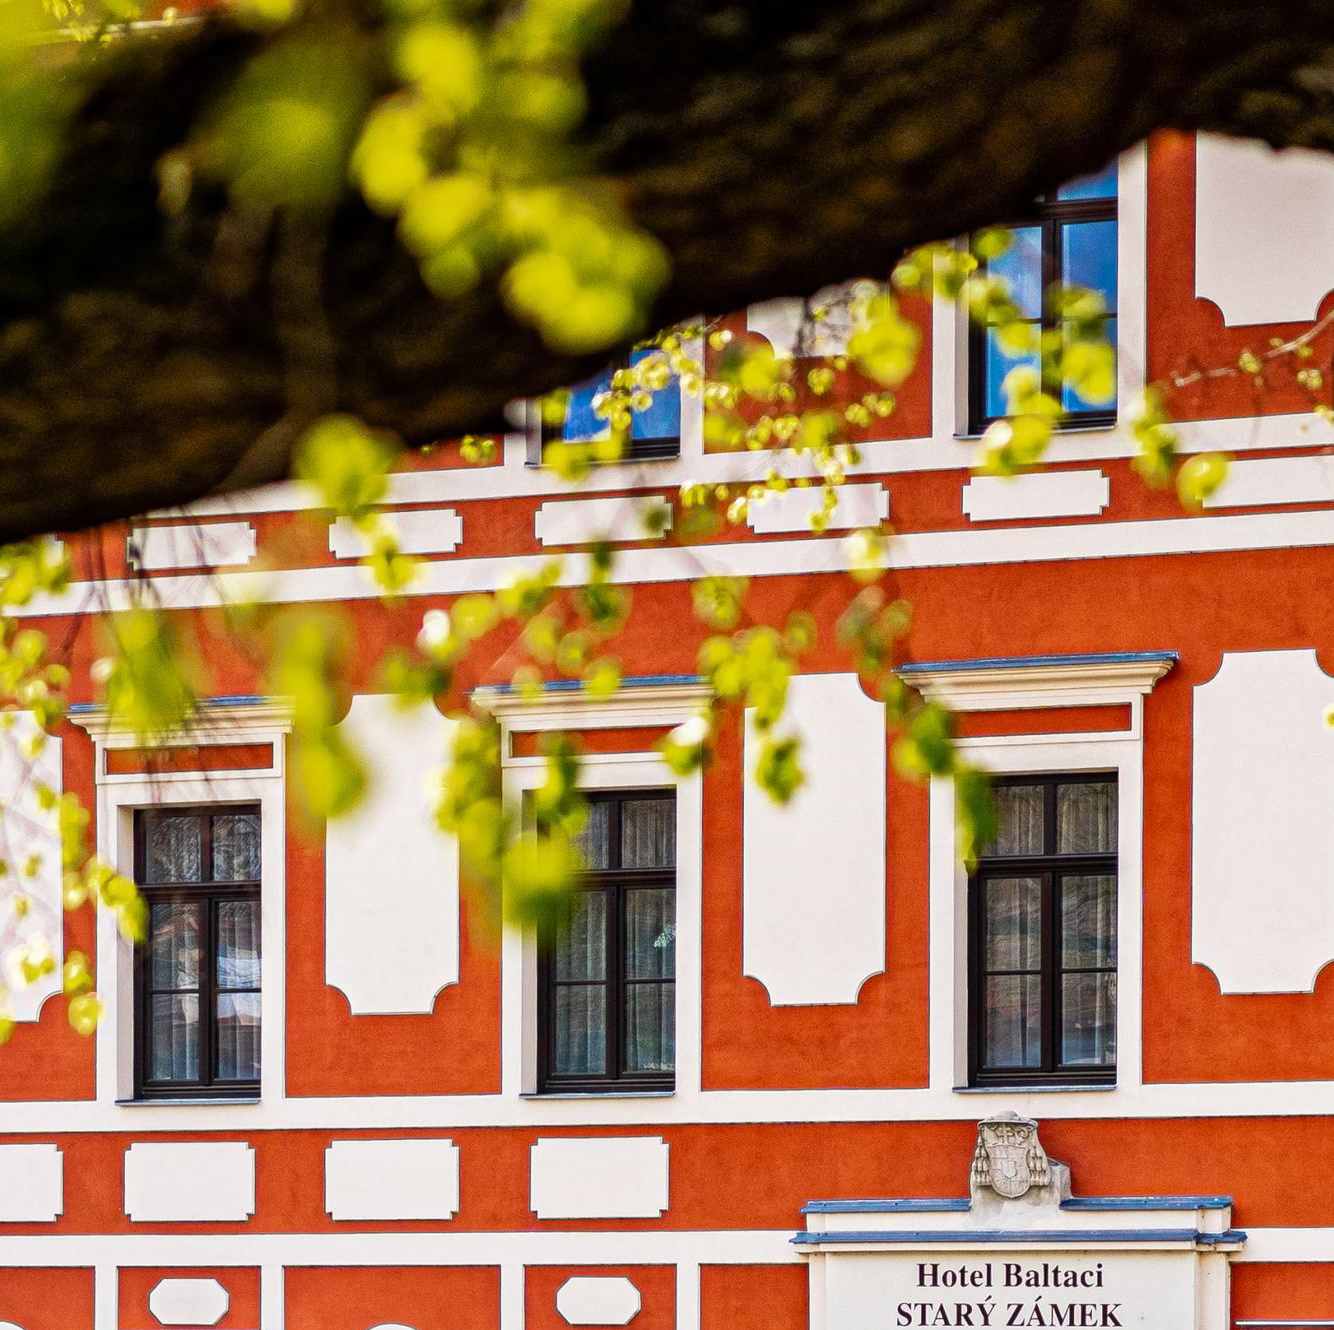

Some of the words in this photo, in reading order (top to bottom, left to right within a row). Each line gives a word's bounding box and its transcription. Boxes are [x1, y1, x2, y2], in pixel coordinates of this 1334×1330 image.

[916, 1263, 993, 1288] Hotel
[1003, 1263, 1104, 1288] Baltaci
[896, 1295, 996, 1327] STARÝ
[1006, 1295, 1123, 1327] ZÁMEK
